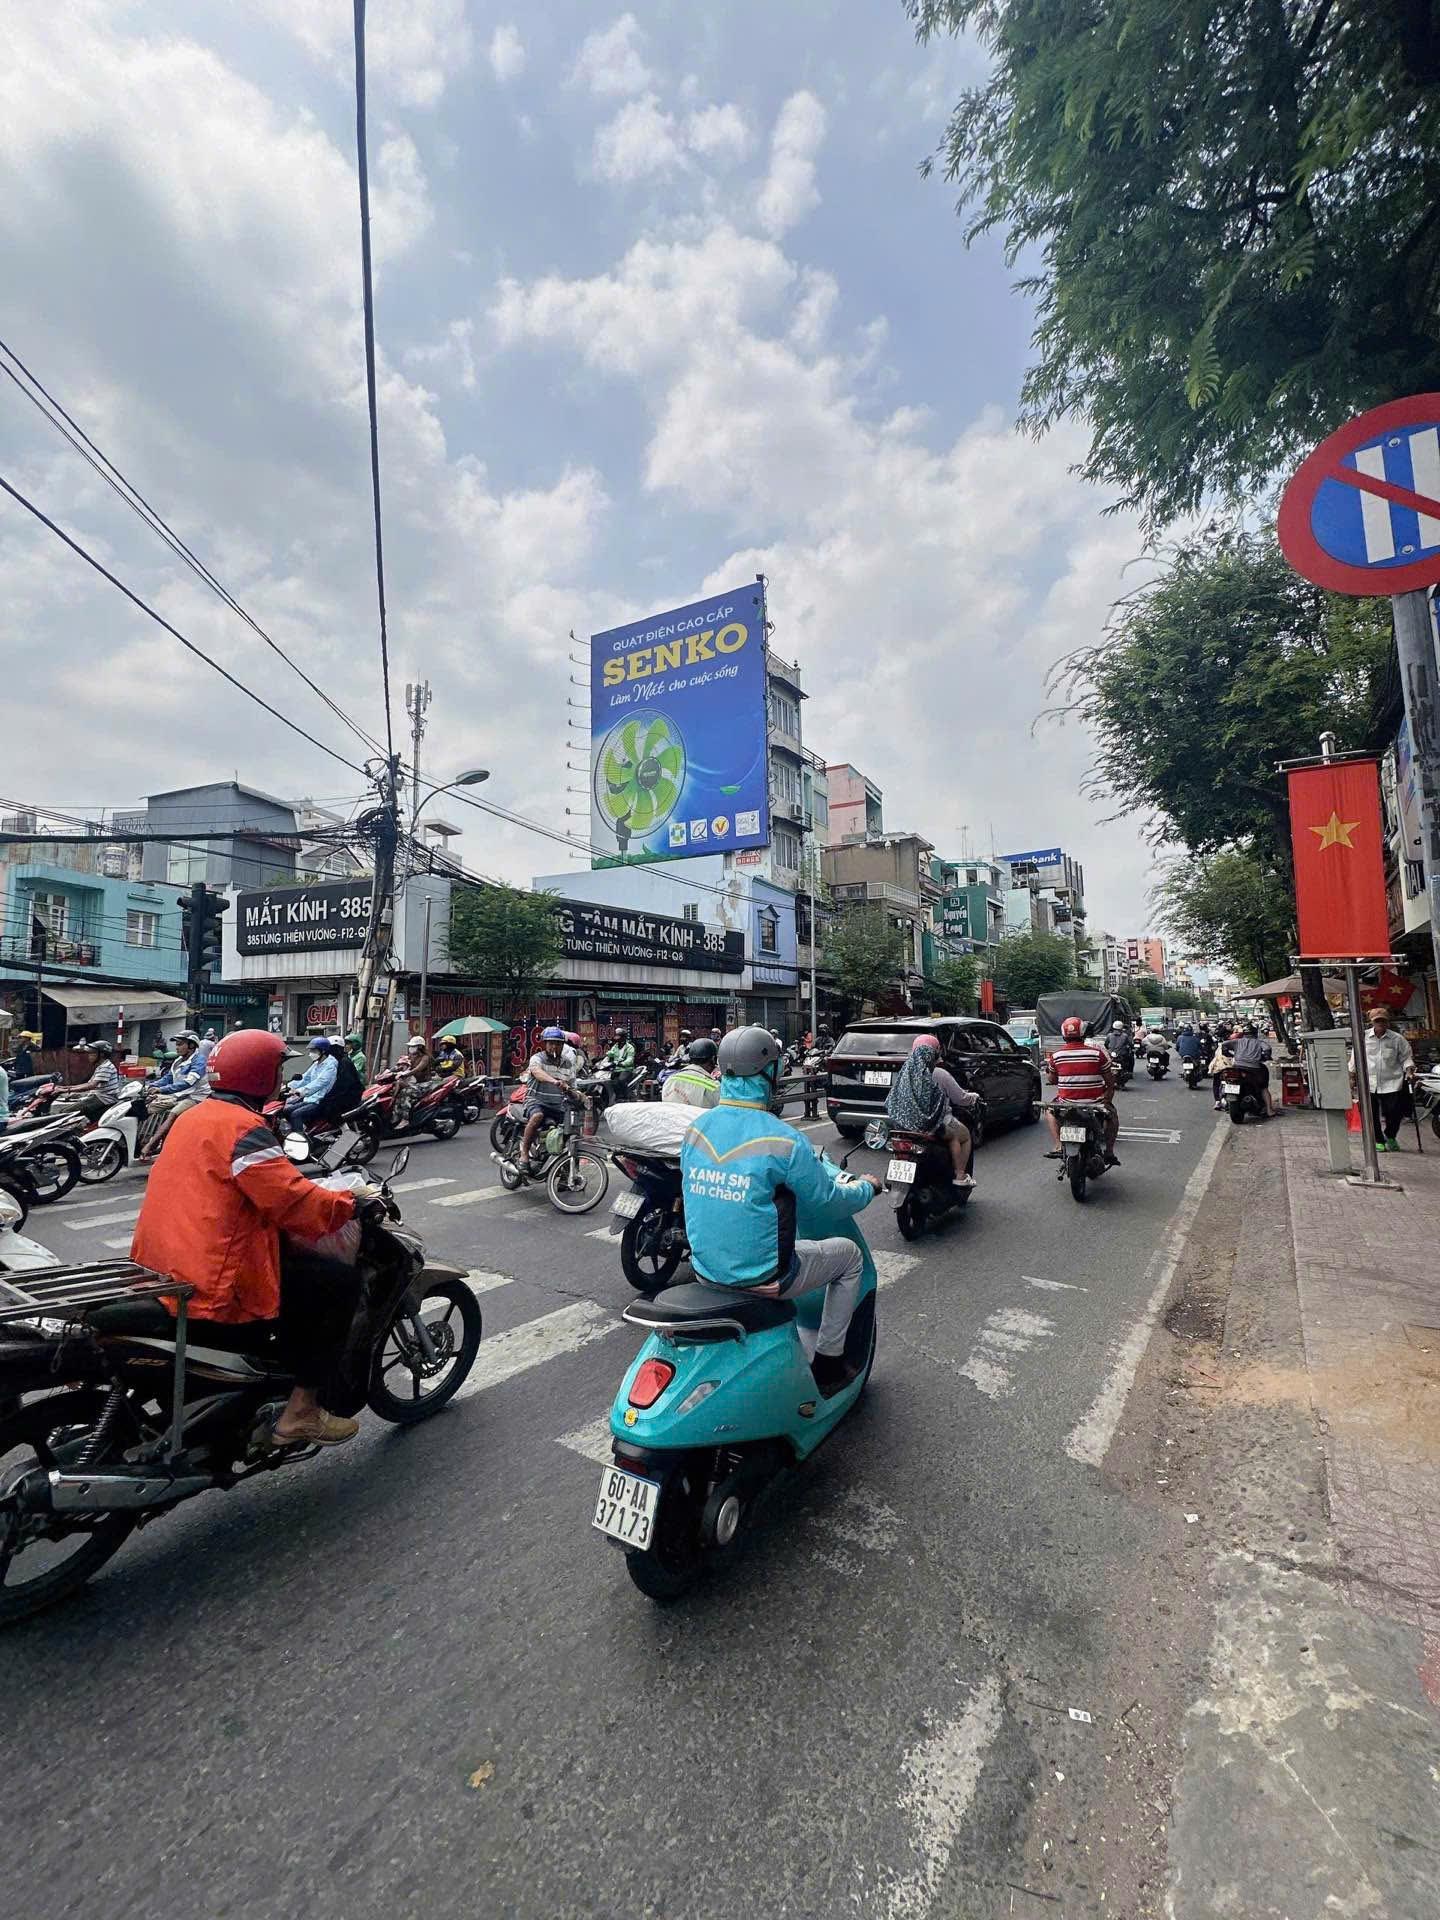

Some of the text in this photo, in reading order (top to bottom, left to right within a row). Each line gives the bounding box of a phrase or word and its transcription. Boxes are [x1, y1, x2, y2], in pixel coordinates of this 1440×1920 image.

[613, 607, 733, 651] QUẠT ĐIỆN CAO CẤP
[603, 622, 748, 688] SENKO
[610, 664, 739, 706] Làm Mát cho cuộc sống
[246, 897, 282, 927] MẮT
[287, 895, 327, 923] KÍNH
[340, 897, 371, 918] 385
[283, 929, 305, 945] THIỆN
[595, 941, 620, 956] THIỆN
[622, 915, 655, 939] MẮT
[660, 922, 694, 949] KÍNH
[703, 932, 725, 952] 385
[689, 1167, 751, 1189] XANH SM
[690, 1182, 746, 1202] xin chào!
[596, 1498, 650, 1543] 371.73
